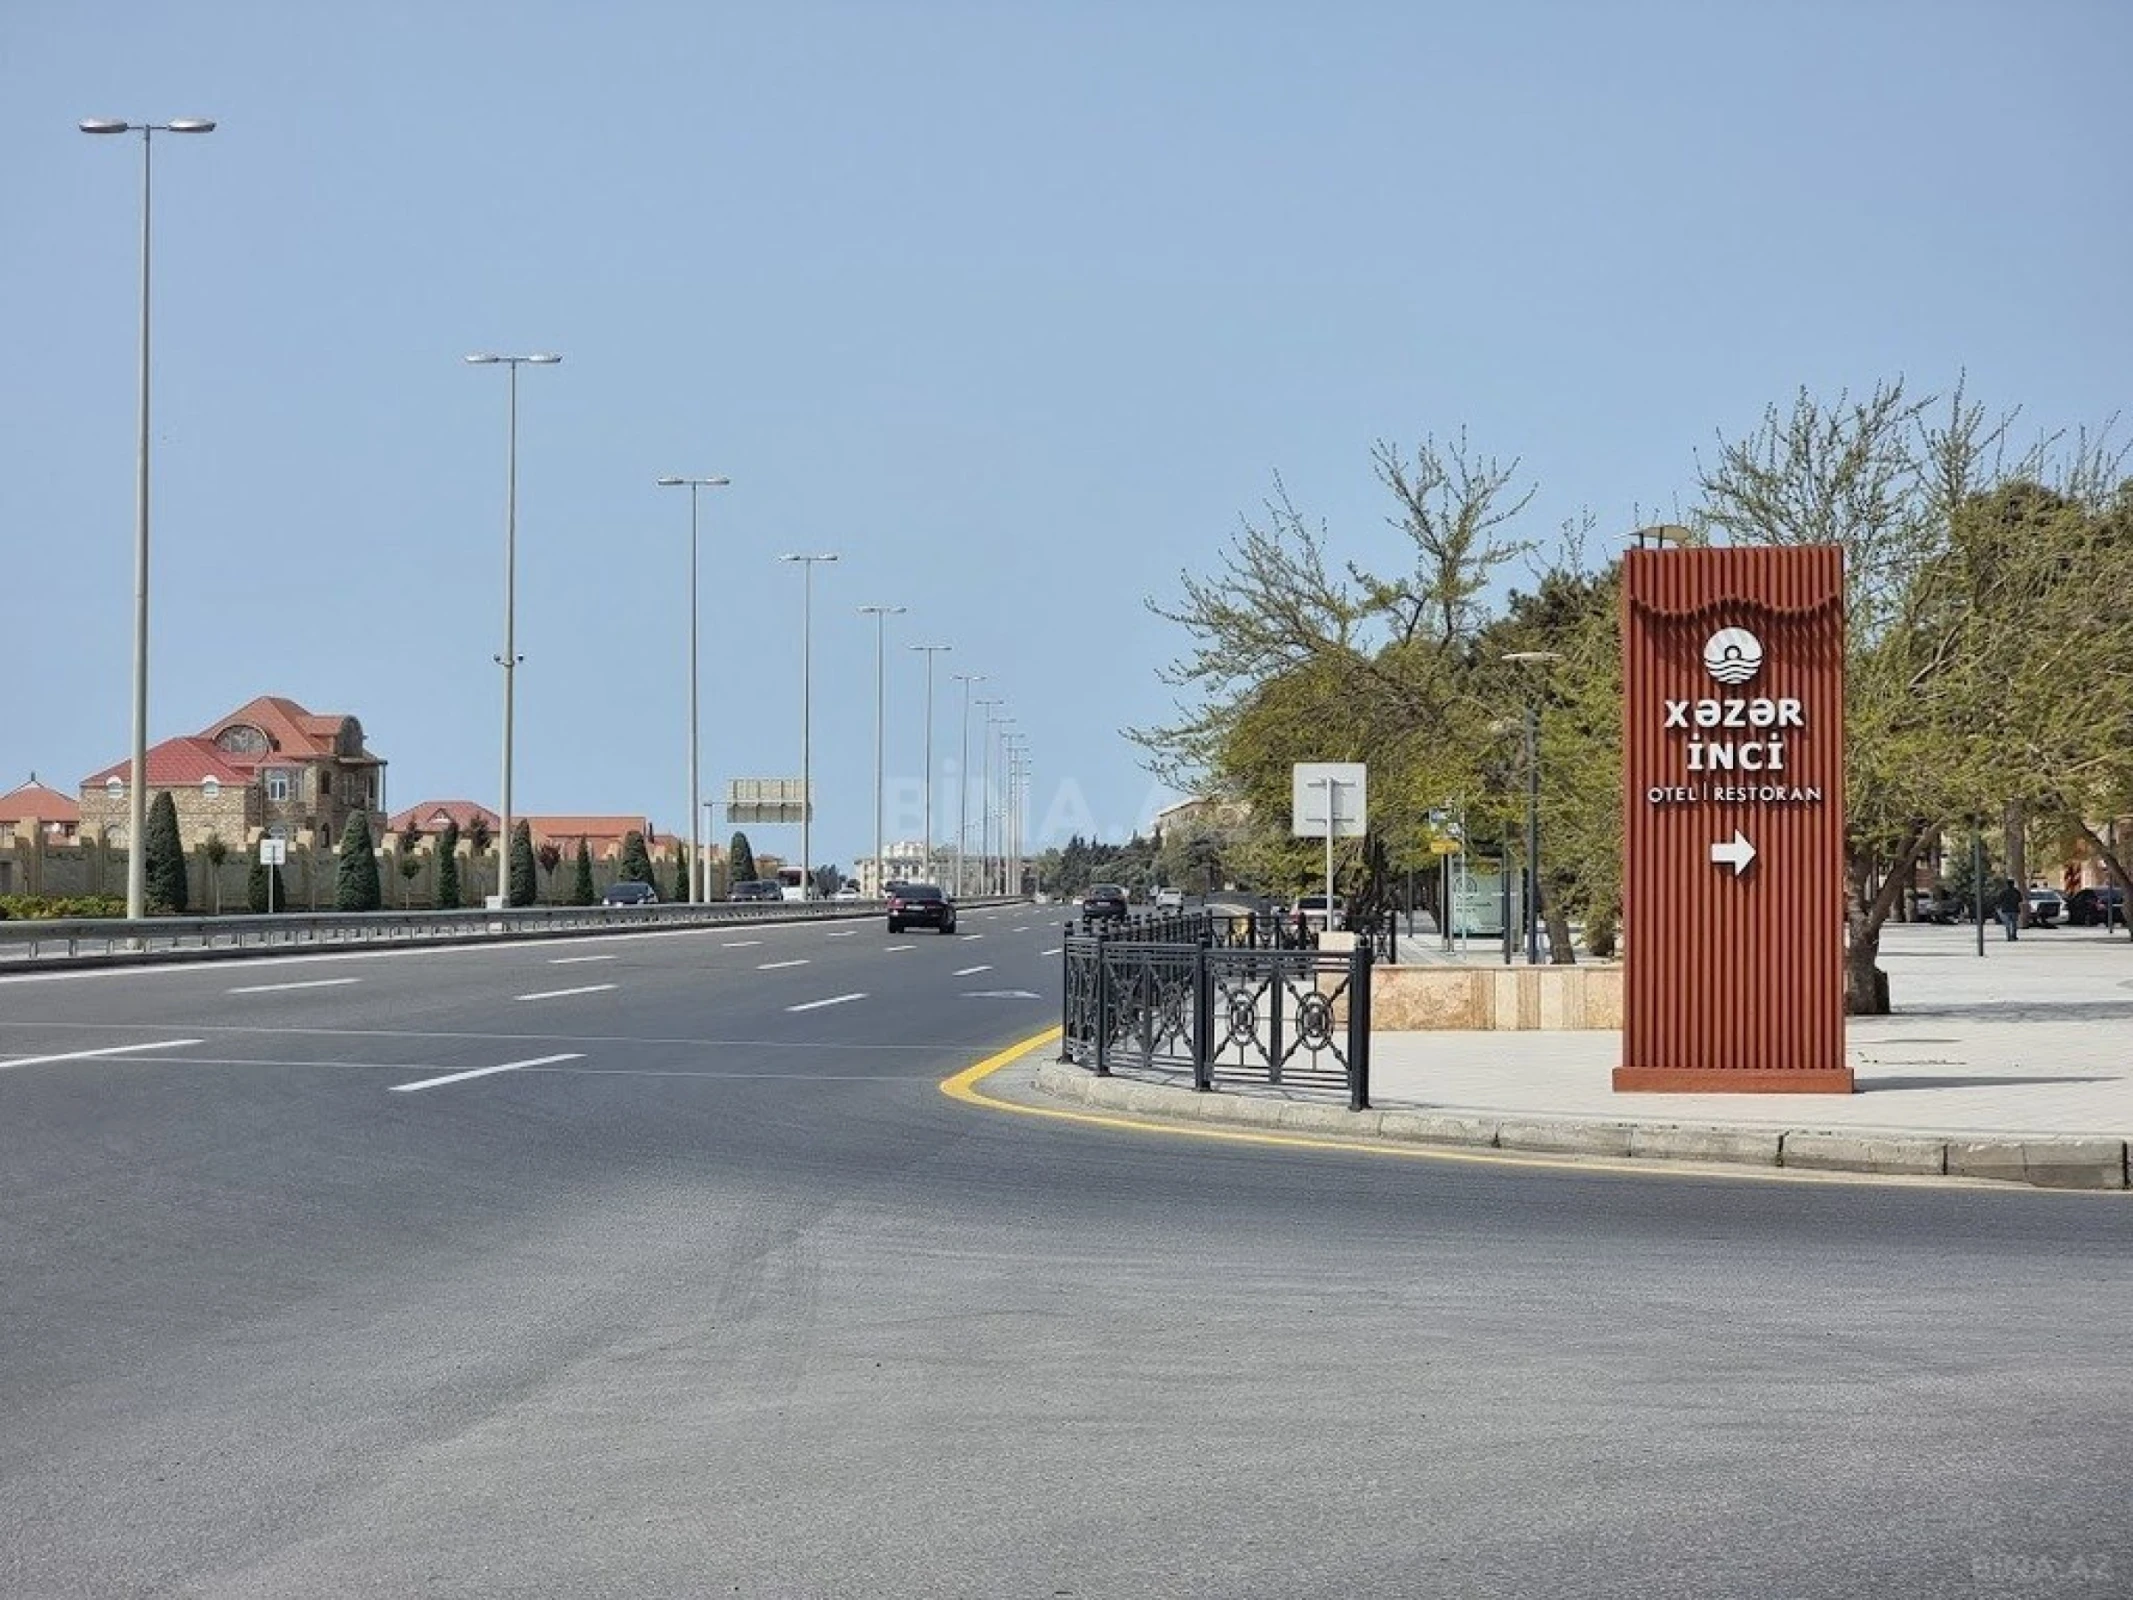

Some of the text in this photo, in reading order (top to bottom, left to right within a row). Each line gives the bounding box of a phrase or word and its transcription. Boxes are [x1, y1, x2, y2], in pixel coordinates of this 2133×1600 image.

[1664, 698, 1804, 728] XƏZƏR
[1687, 732, 1784, 770] İNCİ
[1647, 786, 1821, 803] OTEL RESTORAN
